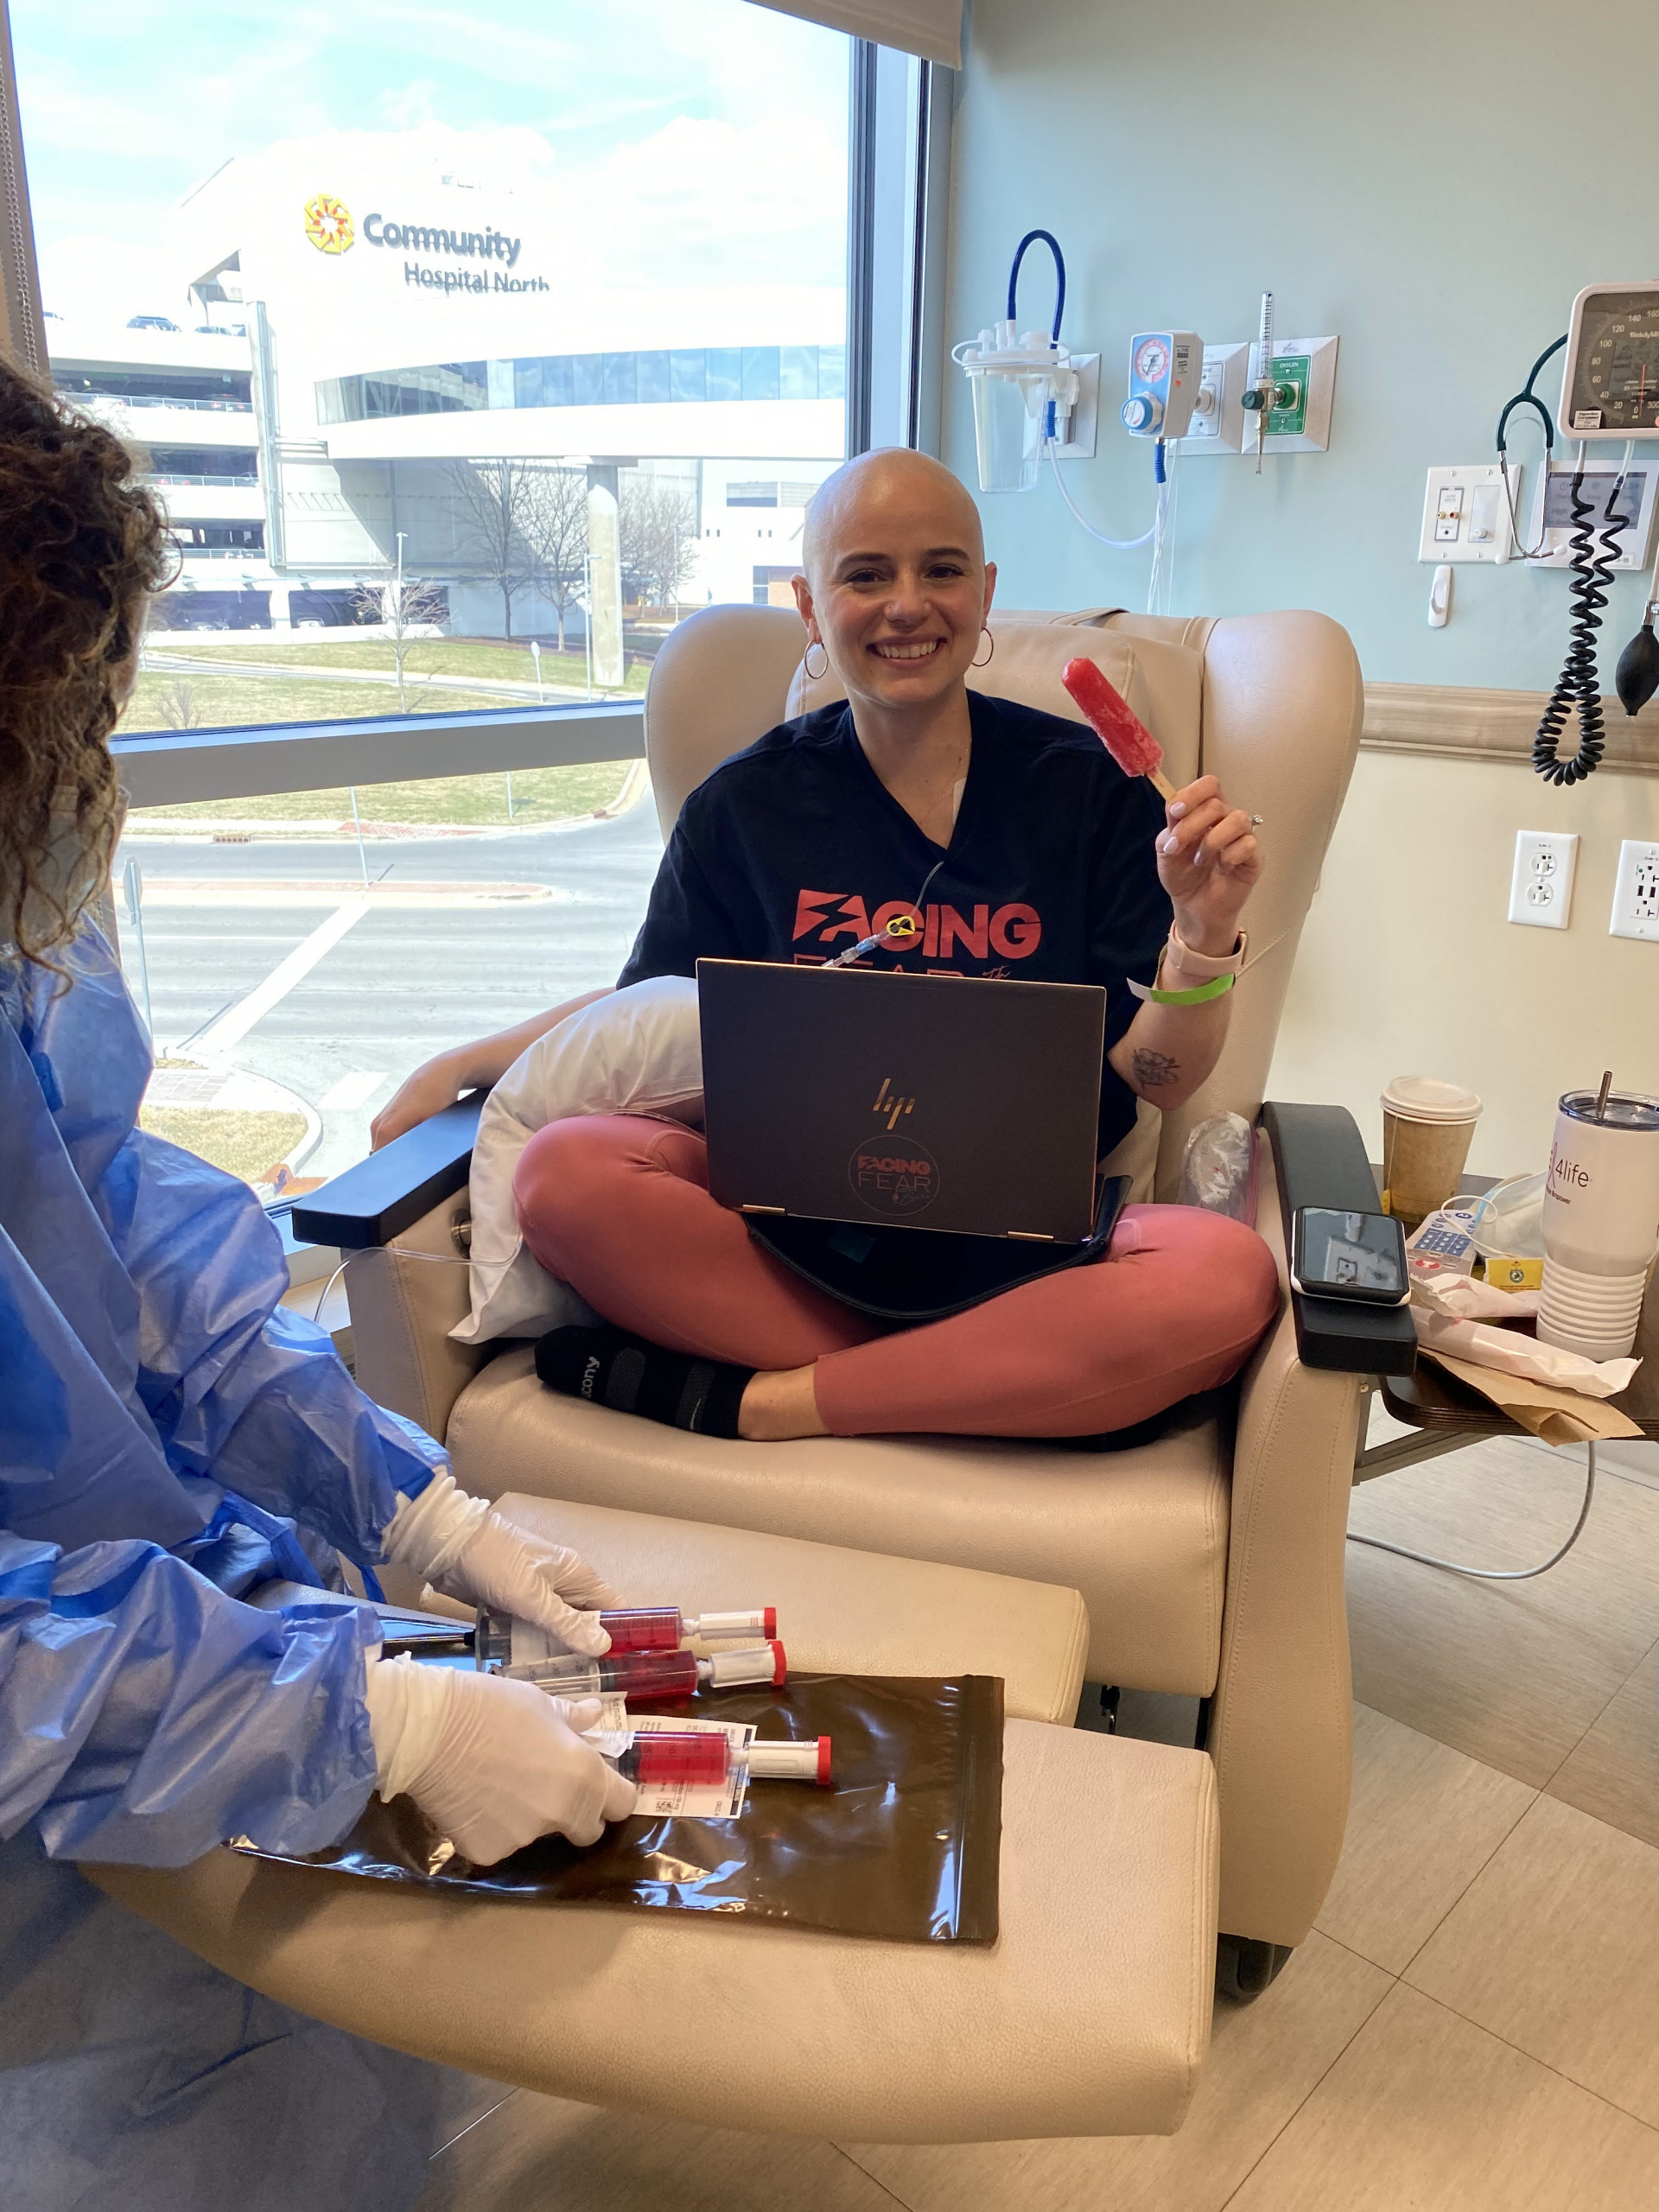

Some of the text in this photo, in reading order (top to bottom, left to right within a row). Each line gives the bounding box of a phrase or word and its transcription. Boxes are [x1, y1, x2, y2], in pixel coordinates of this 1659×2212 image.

[363, 213, 521, 269] Community
[404, 261, 550, 297] Hospital North
[1611, 324, 1625, 333] 120
[1628, 314, 1642, 322] 140
[1599, 339, 1612, 347] 100
[1592, 375, 1602, 384] 60
[1599, 391, 1609, 399] 40
[791, 889, 1042, 959] FACING
[873, 1077, 916, 1130] hp
[857, 1155, 931, 1176] FACING
[1555, 1159, 1589, 1187] 4life
[858, 1171, 931, 1192] FEAR
